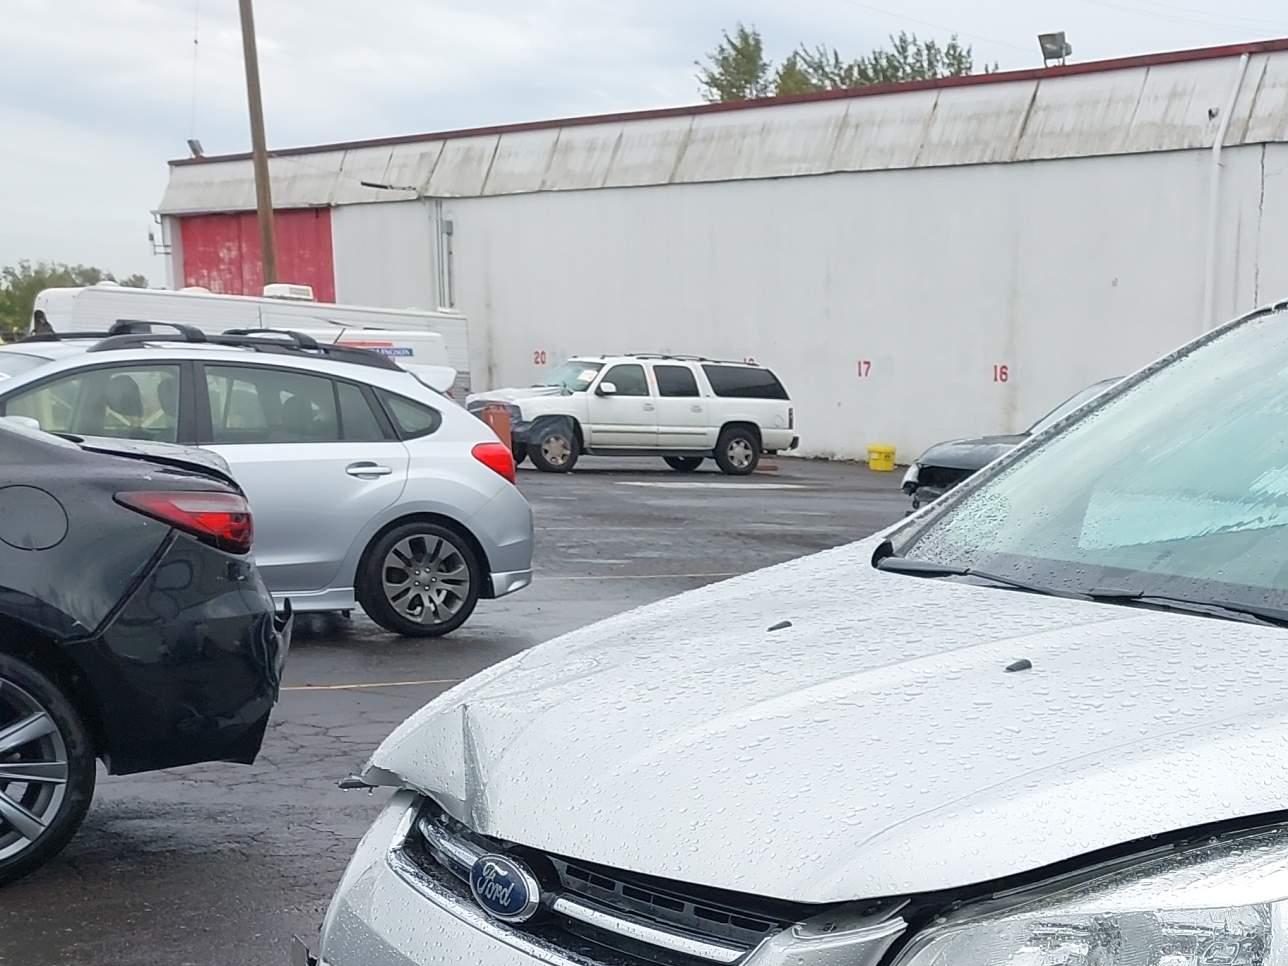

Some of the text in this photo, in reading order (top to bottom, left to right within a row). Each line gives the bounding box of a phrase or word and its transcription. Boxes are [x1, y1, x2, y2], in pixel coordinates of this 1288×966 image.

[533, 350, 546, 365] 20
[857, 360, 872, 377] 17
[993, 364, 1009, 382] 16
[476, 861, 515, 907] Ford
